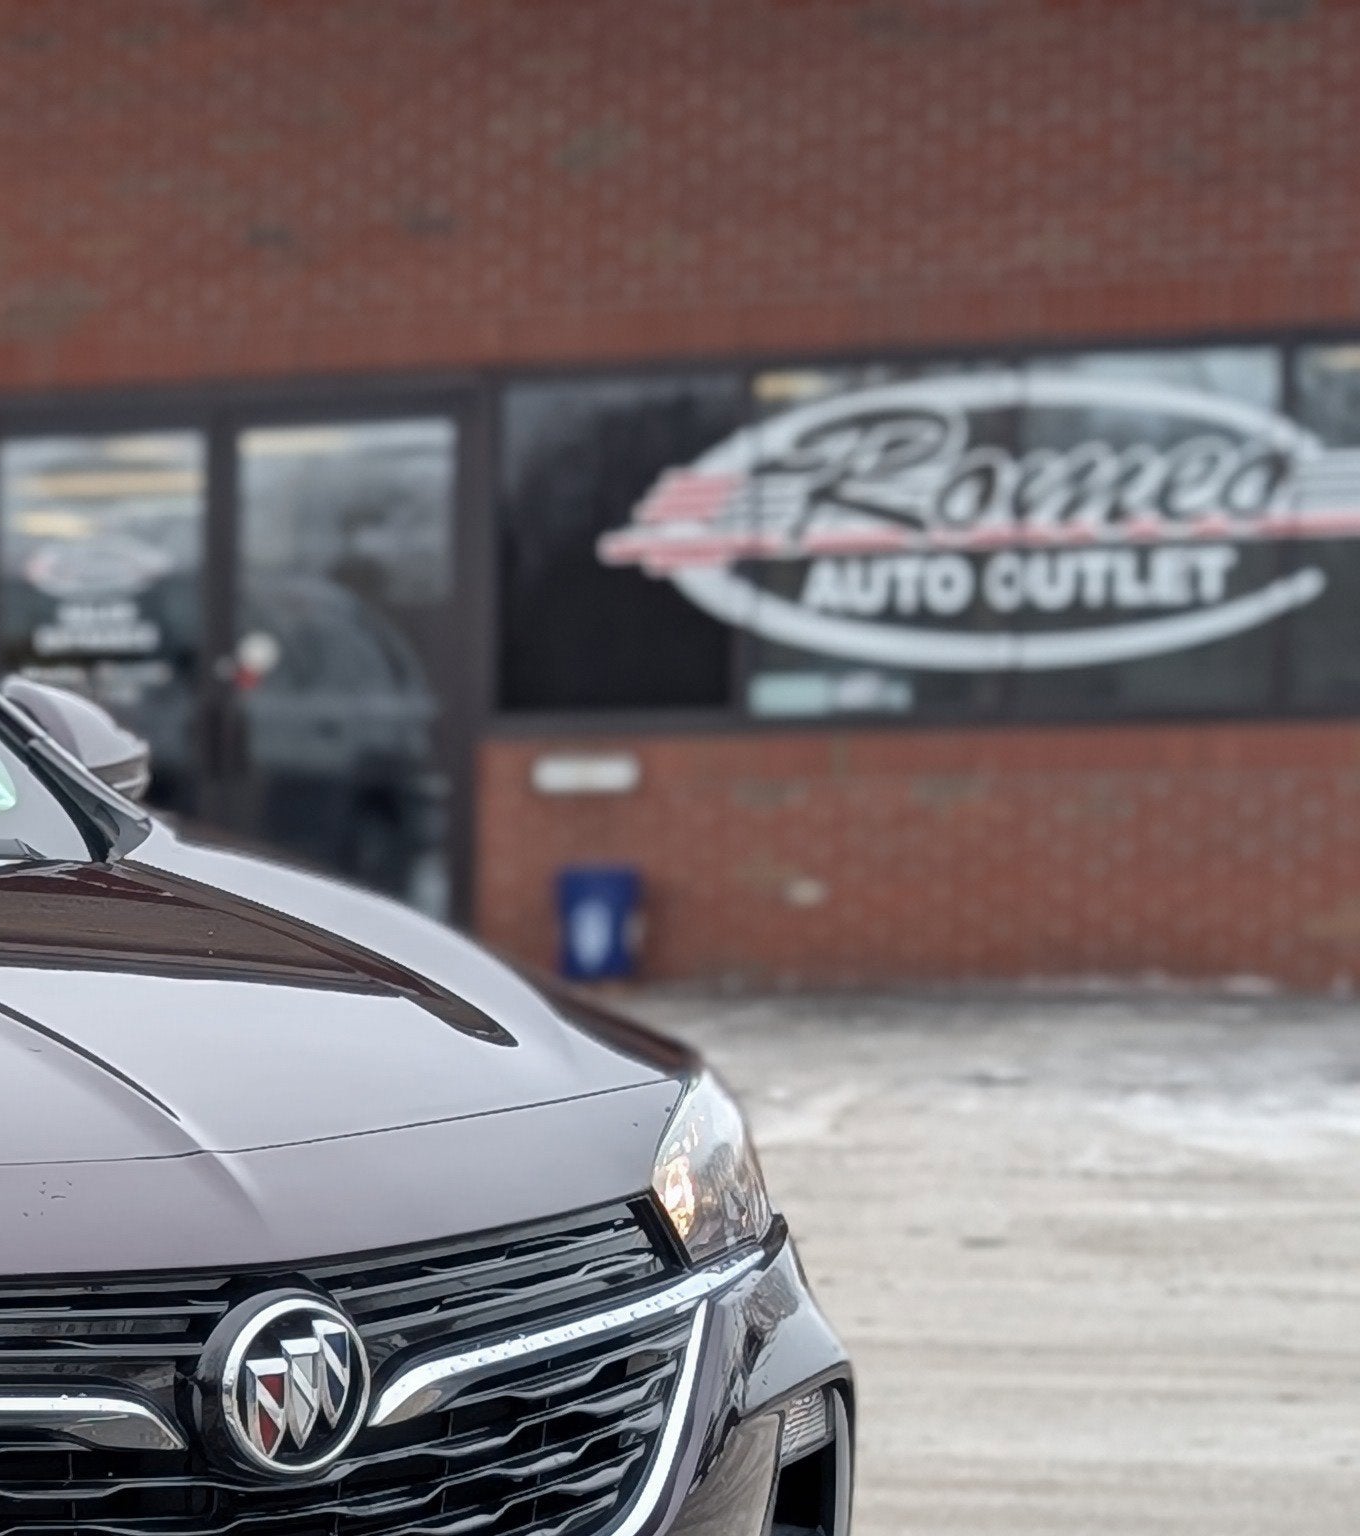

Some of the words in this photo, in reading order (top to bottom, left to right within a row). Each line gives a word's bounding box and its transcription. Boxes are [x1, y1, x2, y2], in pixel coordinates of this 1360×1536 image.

[750, 404, 1298, 542] Romeo
[801, 554, 975, 616] AUTO
[983, 545, 1237, 613] OUTLET
